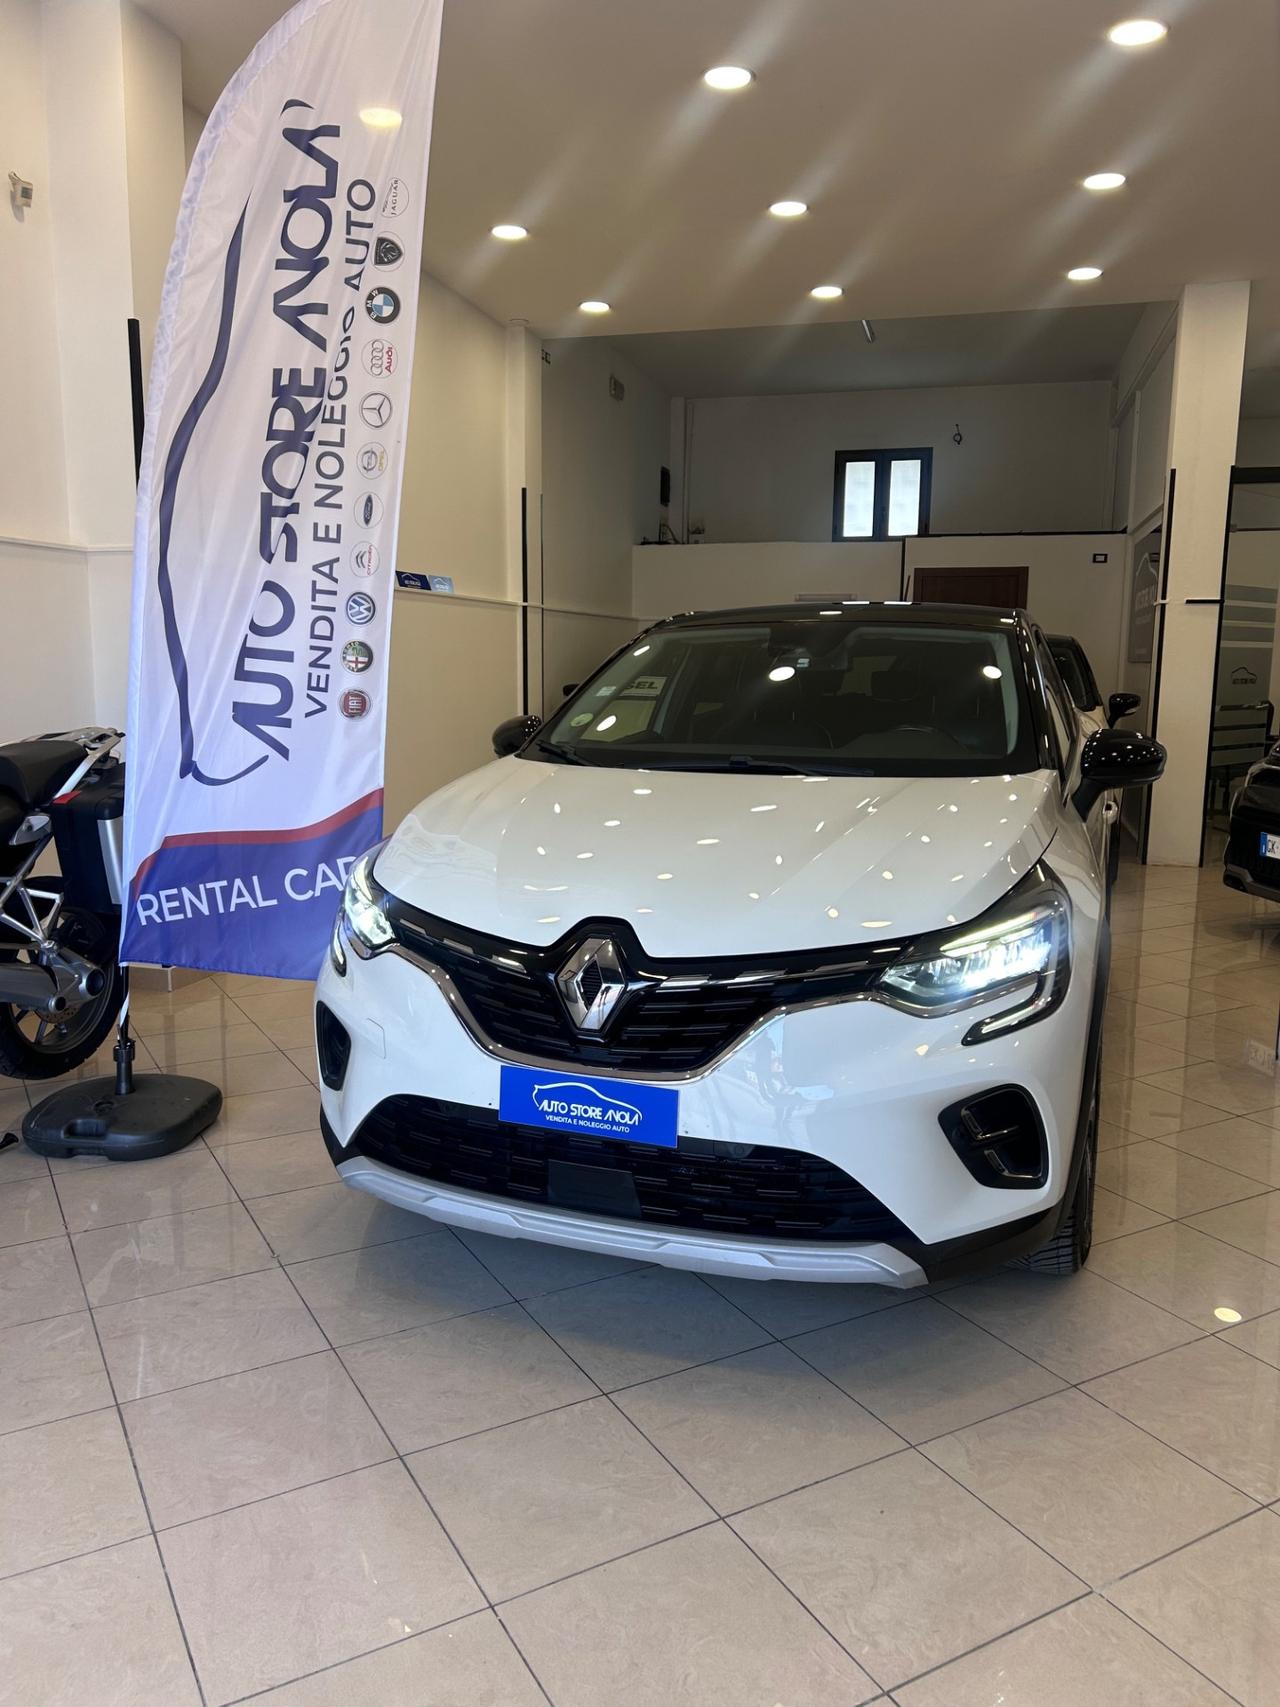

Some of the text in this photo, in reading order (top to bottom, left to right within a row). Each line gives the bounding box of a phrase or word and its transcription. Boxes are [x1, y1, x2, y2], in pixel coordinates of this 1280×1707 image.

[259, 367, 327, 564] STORE
[304, 178, 376, 718] VENDITA E NOLEGGIO AUTO
[232, 579, 296, 761] AUTO
[136, 875, 278, 926] RENTAL
[539, 1099, 568, 1114] AUTO
[570, 1103, 602, 1120] STORE
[545, 1114, 572, 1125] VENDITA
[578, 1119, 611, 1130] NOLEGGIO
[612, 1125, 630, 1133] AUTO
